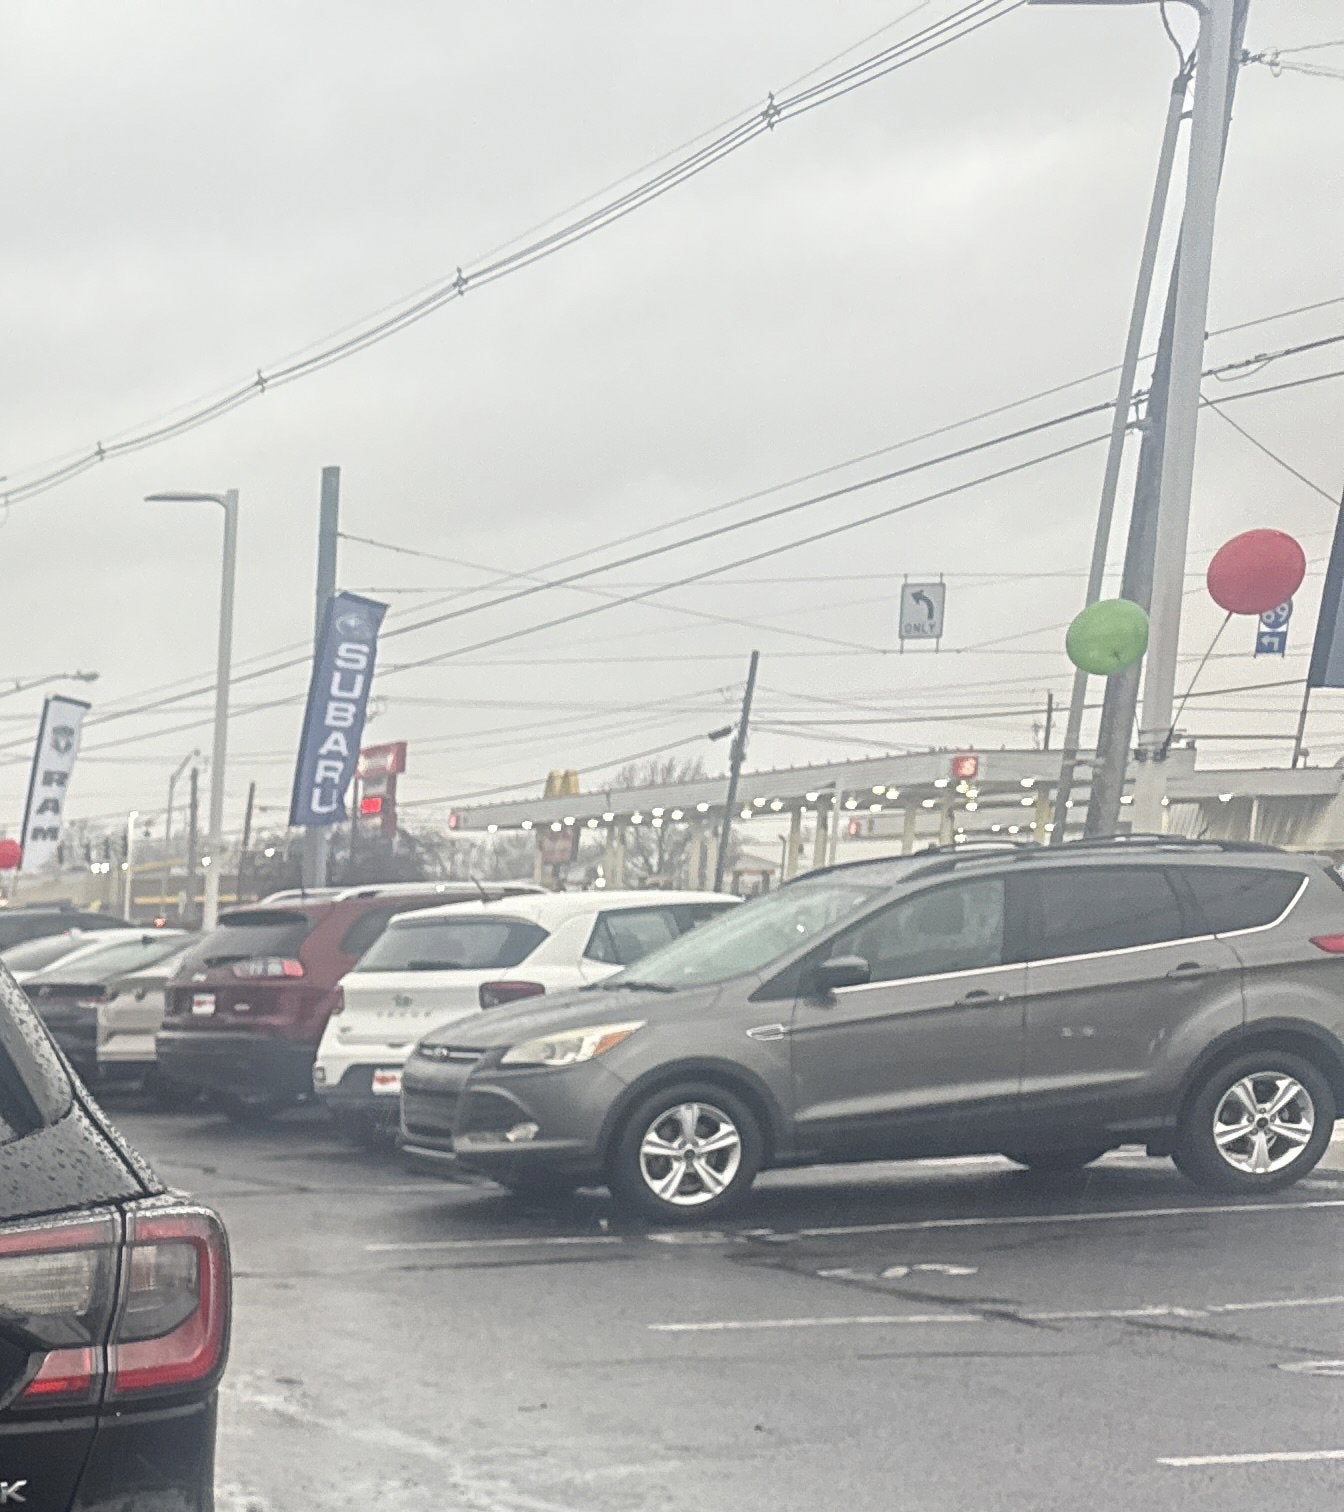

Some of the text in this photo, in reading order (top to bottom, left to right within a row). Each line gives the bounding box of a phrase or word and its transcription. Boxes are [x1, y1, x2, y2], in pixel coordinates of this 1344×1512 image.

[904, 623, 937, 634] ONLY
[311, 642, 369, 814] SUBARU
[31, 770, 69, 841] RAM
